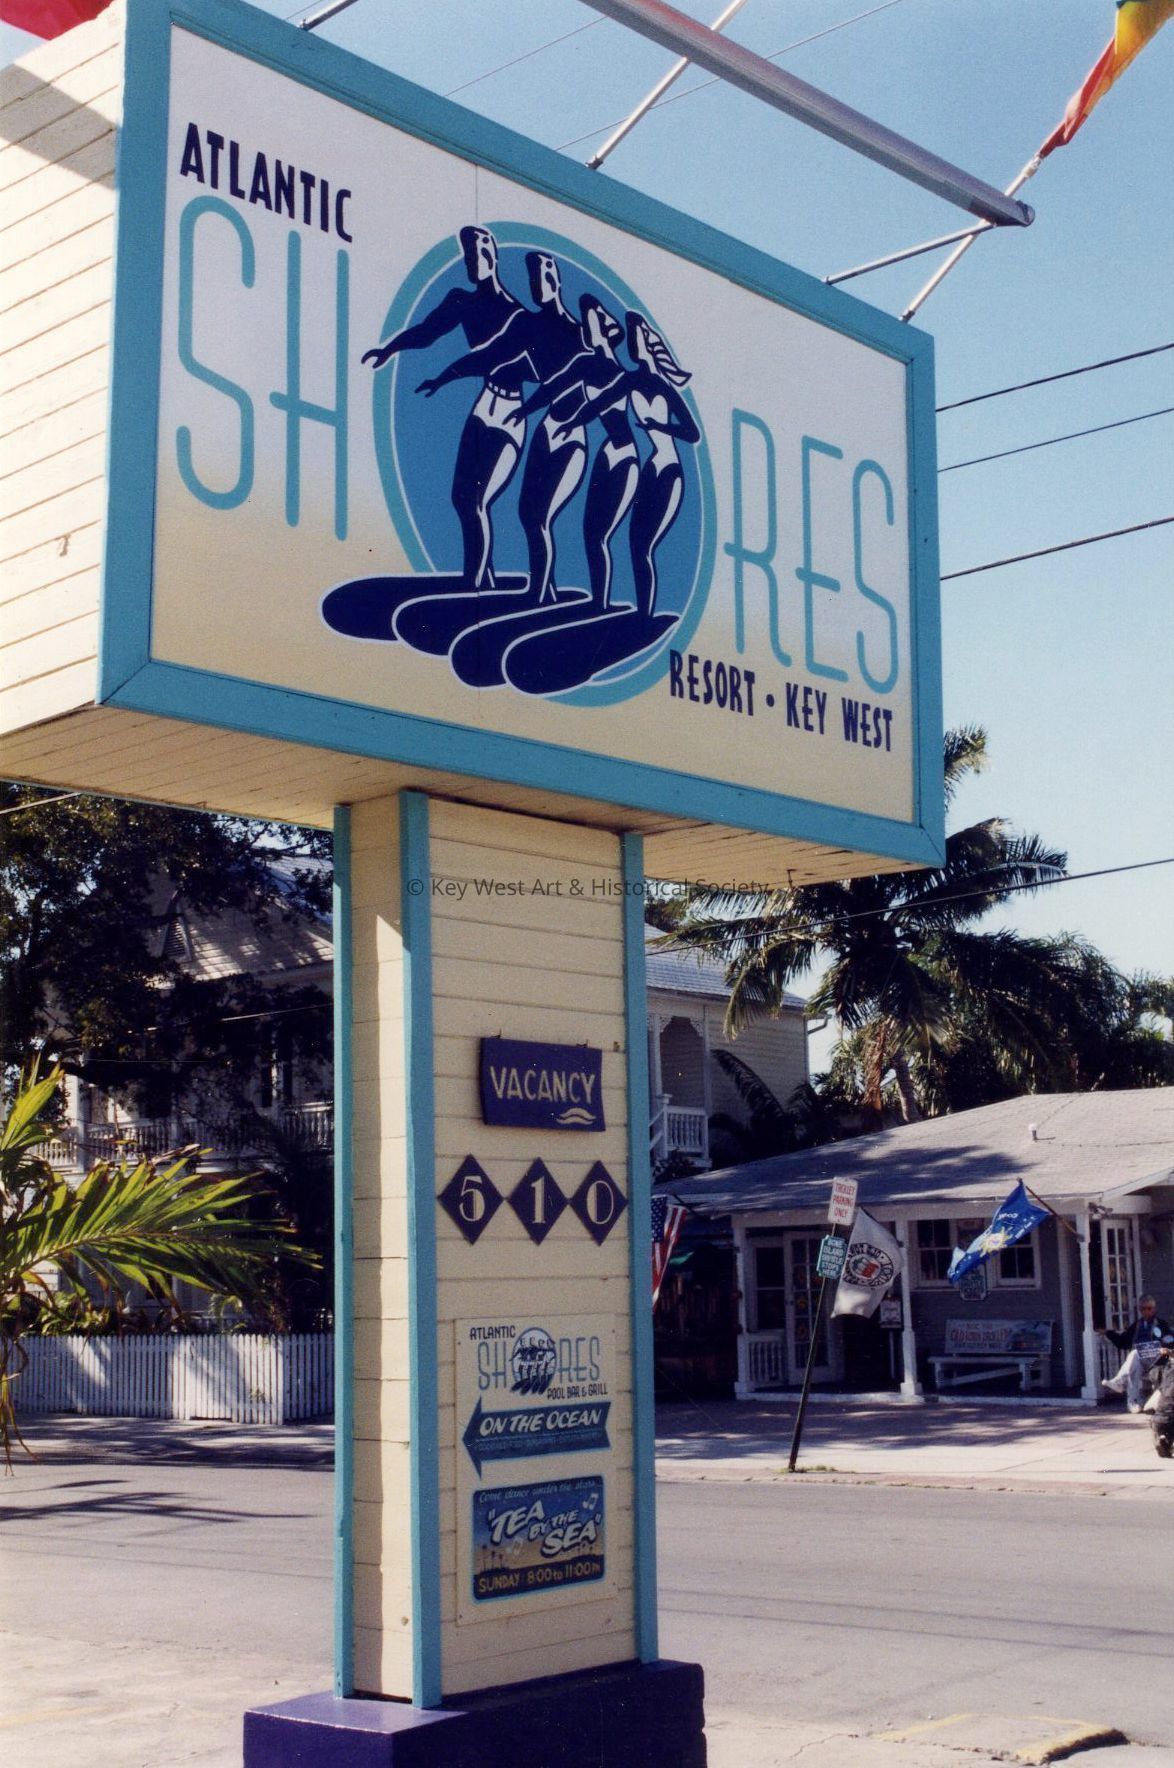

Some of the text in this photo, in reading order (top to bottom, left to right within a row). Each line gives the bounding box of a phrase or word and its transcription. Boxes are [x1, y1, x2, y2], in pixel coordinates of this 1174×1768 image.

[180, 122, 352, 243] ATLANTIC
[669, 649, 893, 752] RESORT KEY WEST
[489, 1066, 596, 1104] VACANCY
[833, 1196, 853, 1208] PARKING
[470, 1325, 516, 1340] ATLANTIC
[547, 1388, 565, 1400] POOL
[567, 1387, 580, 1399] BAR
[588, 1383, 608, 1396] GRILL
[479, 1409, 602, 1437] ON THE OCEAN
[479, 1492, 501, 1503] Come
[504, 1489, 530, 1499] dance
[559, 1483, 571, 1492] the
[529, 1509, 579, 1538] BY THE
[479, 1573, 521, 1593] SUNDAY
[553, 1571, 563, 1580] to
